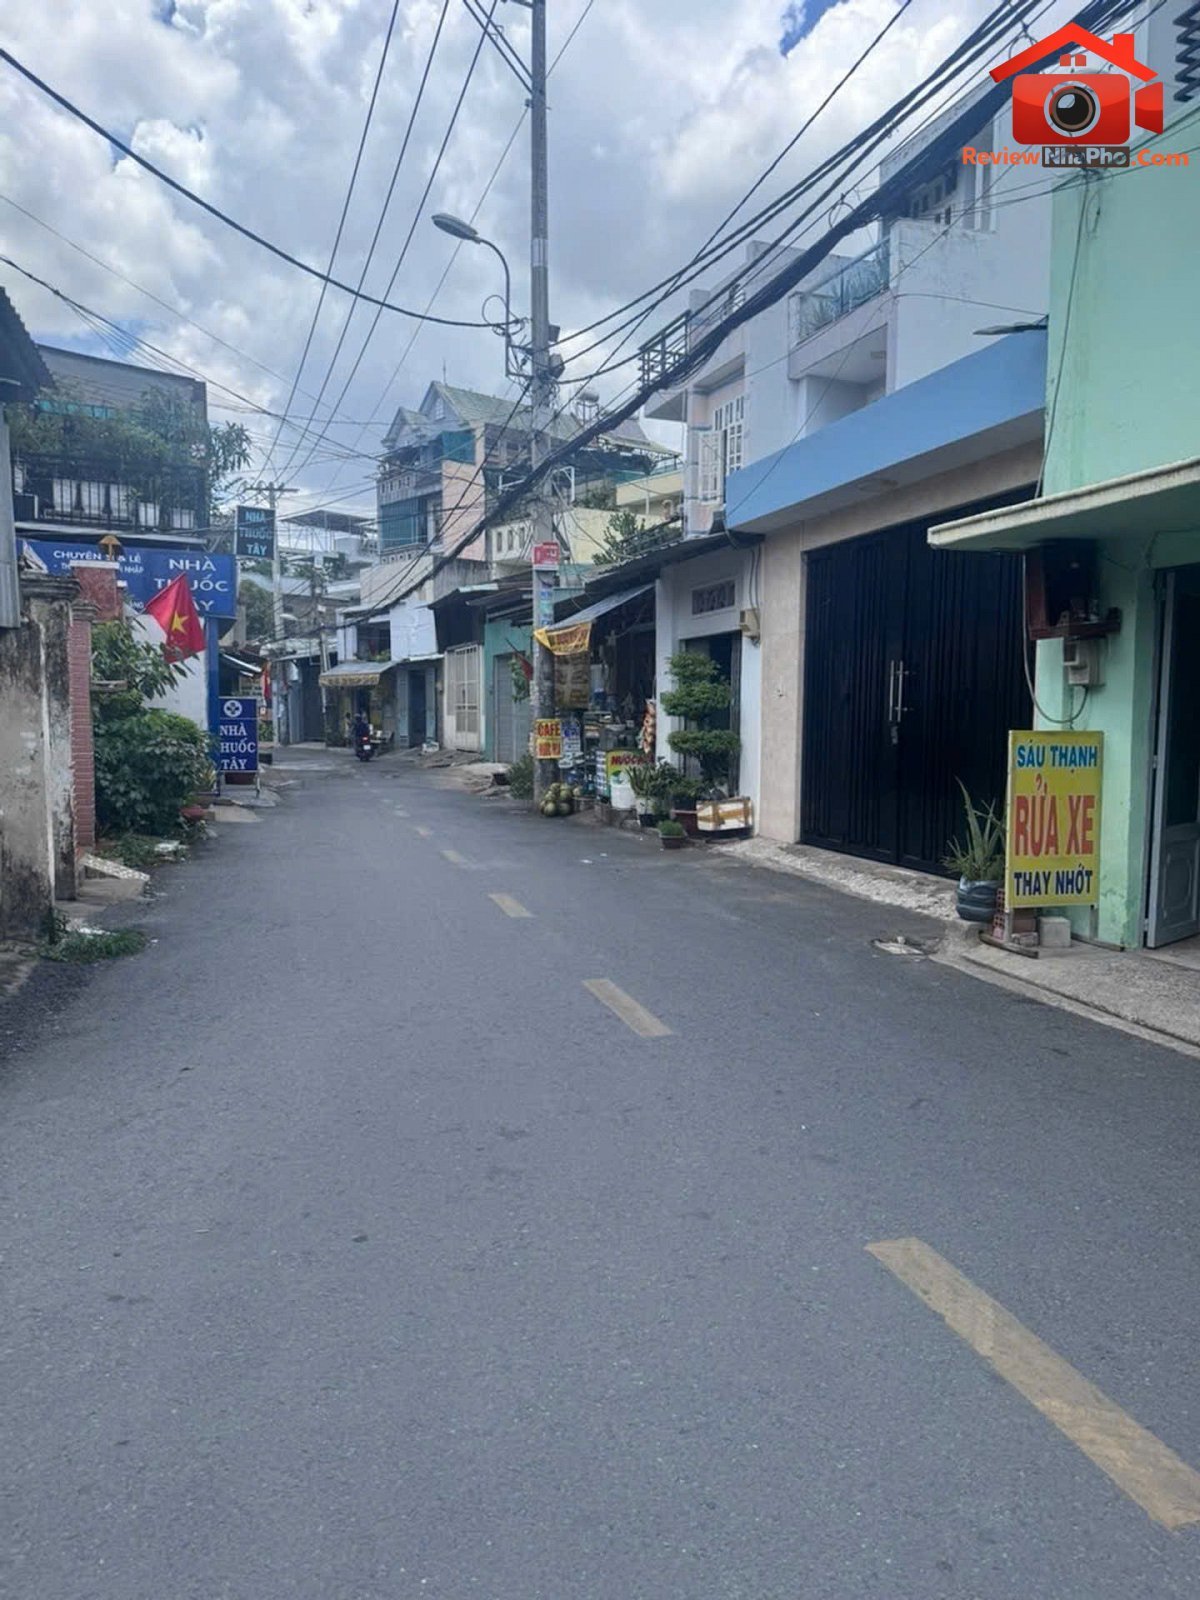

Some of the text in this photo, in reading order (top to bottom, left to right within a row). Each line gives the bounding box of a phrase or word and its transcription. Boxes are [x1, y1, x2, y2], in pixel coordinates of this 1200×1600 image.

[53, 550, 102, 560] CHUYÊN
[246, 542, 267, 556] TÂY
[168, 555, 217, 572] NHÀ
[153, 573, 229, 592] TUỐC
[220, 723, 247, 736] NHÀ
[220, 737, 256, 753] HUỐC
[220, 757, 247, 770] TÂY
[1017, 739, 1098, 774] SÁU THẠNH
[1014, 773, 1095, 857] RỬA XE
[1014, 863, 1094, 896] THAY NHỚT
